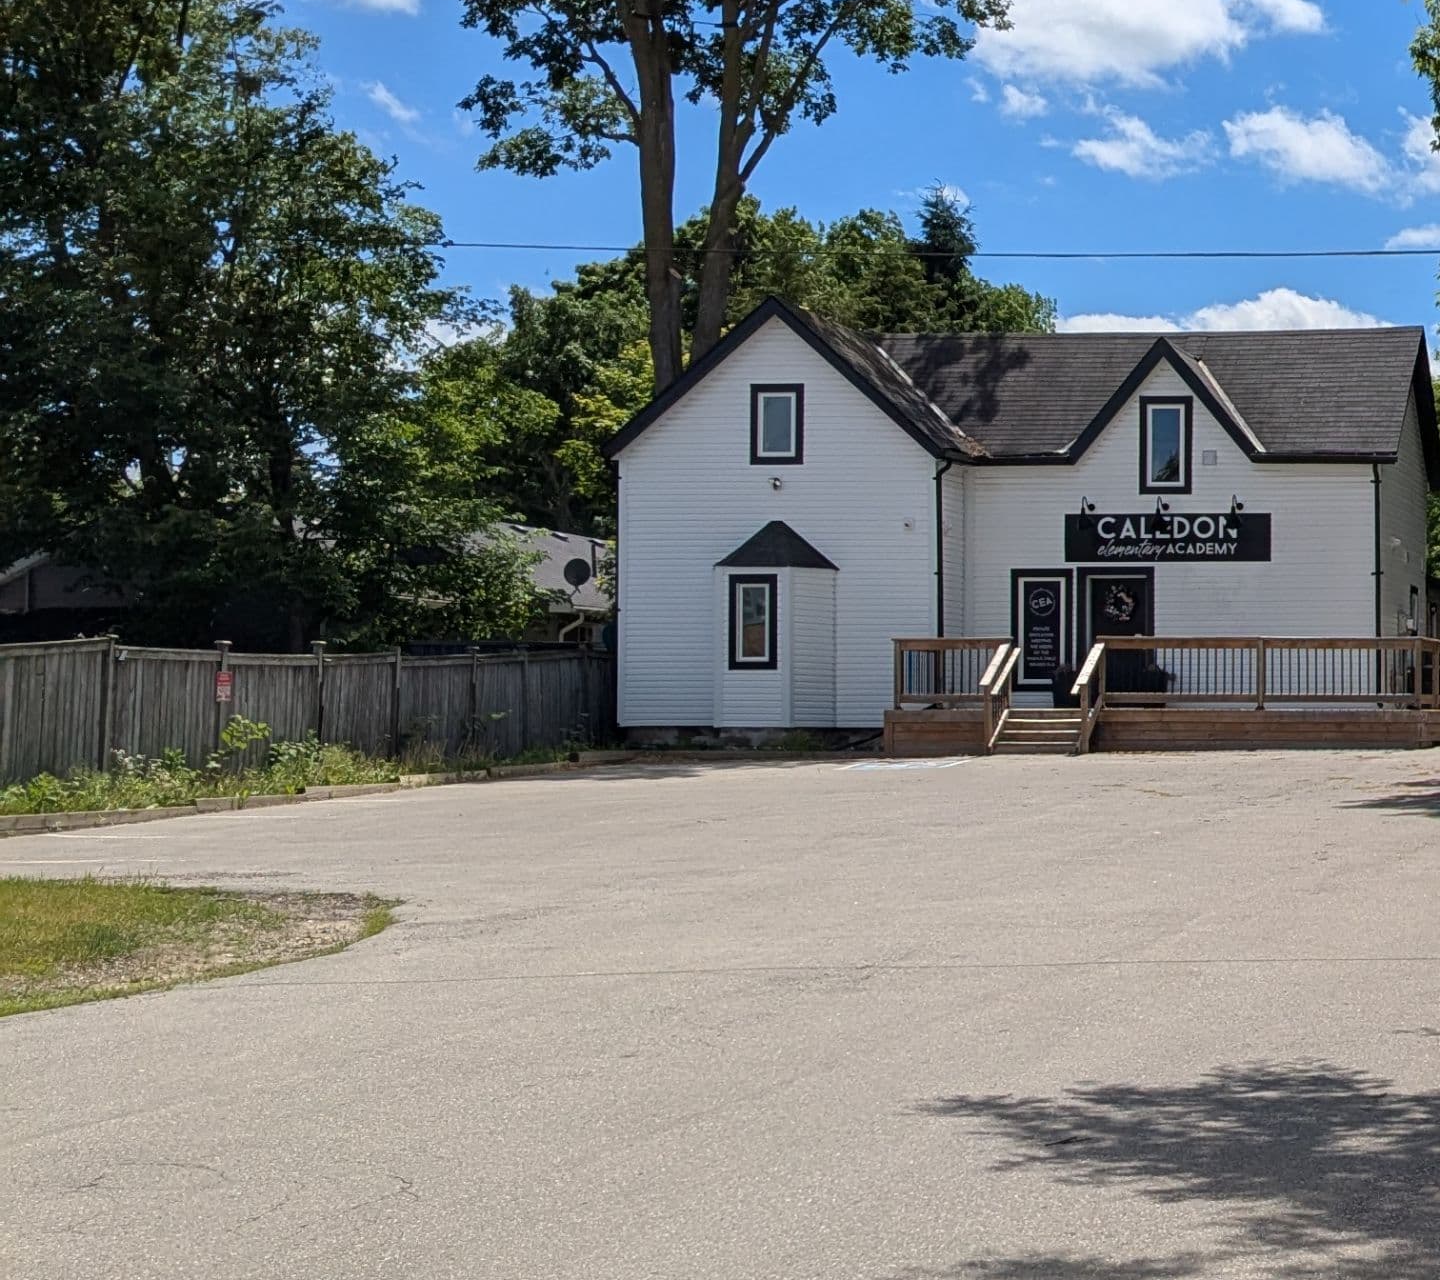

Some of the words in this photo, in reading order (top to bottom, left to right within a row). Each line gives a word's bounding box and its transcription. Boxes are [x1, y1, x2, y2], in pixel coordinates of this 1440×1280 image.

[1097, 539, 1167, 561] elementary
[1166, 543, 1238, 555] ACADEMY
[1031, 597, 1053, 609] CEA
